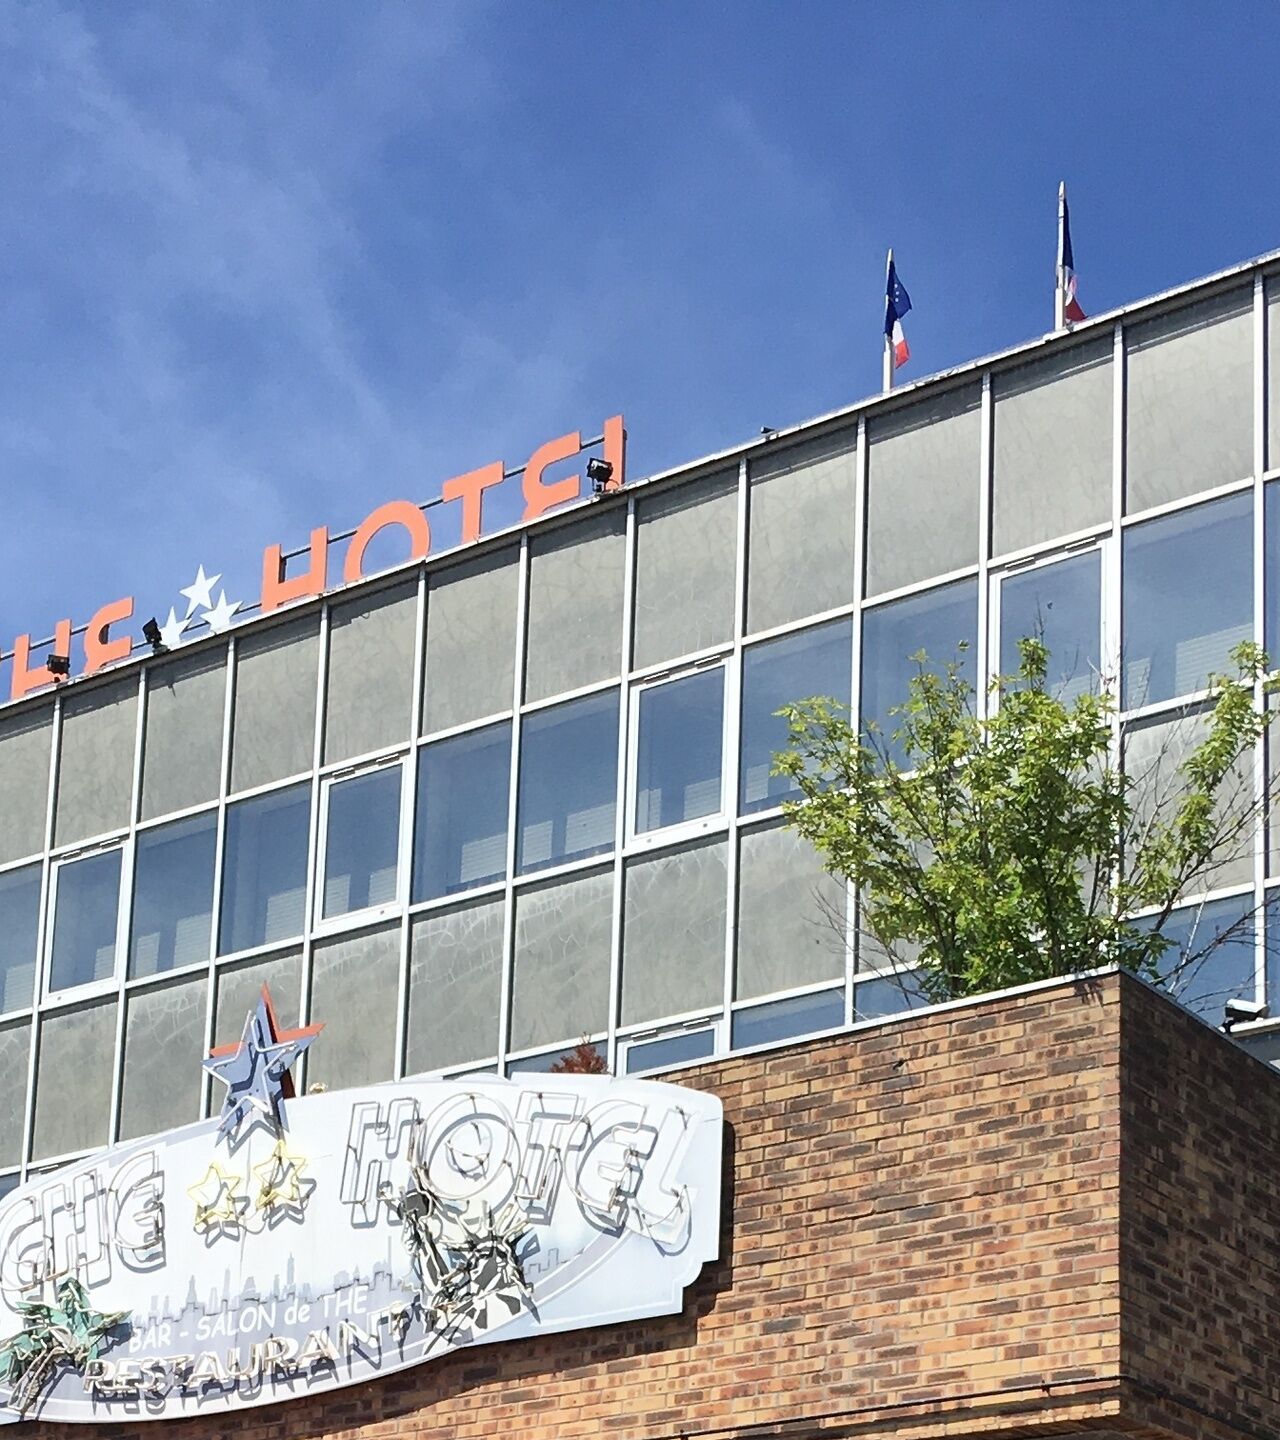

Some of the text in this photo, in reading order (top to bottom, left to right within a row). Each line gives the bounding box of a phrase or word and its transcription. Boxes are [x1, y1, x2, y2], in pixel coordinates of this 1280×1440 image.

[261, 414, 627, 614] HOTEL
[339, 1090, 700, 1256] HOTEL
[83, 1301, 413, 1396] RESTAURANT
[129, 1323, 171, 1354] BAR
[196, 1302, 276, 1342] SALON
[284, 1299, 311, 1326] de
[322, 1285, 370, 1319] THE
